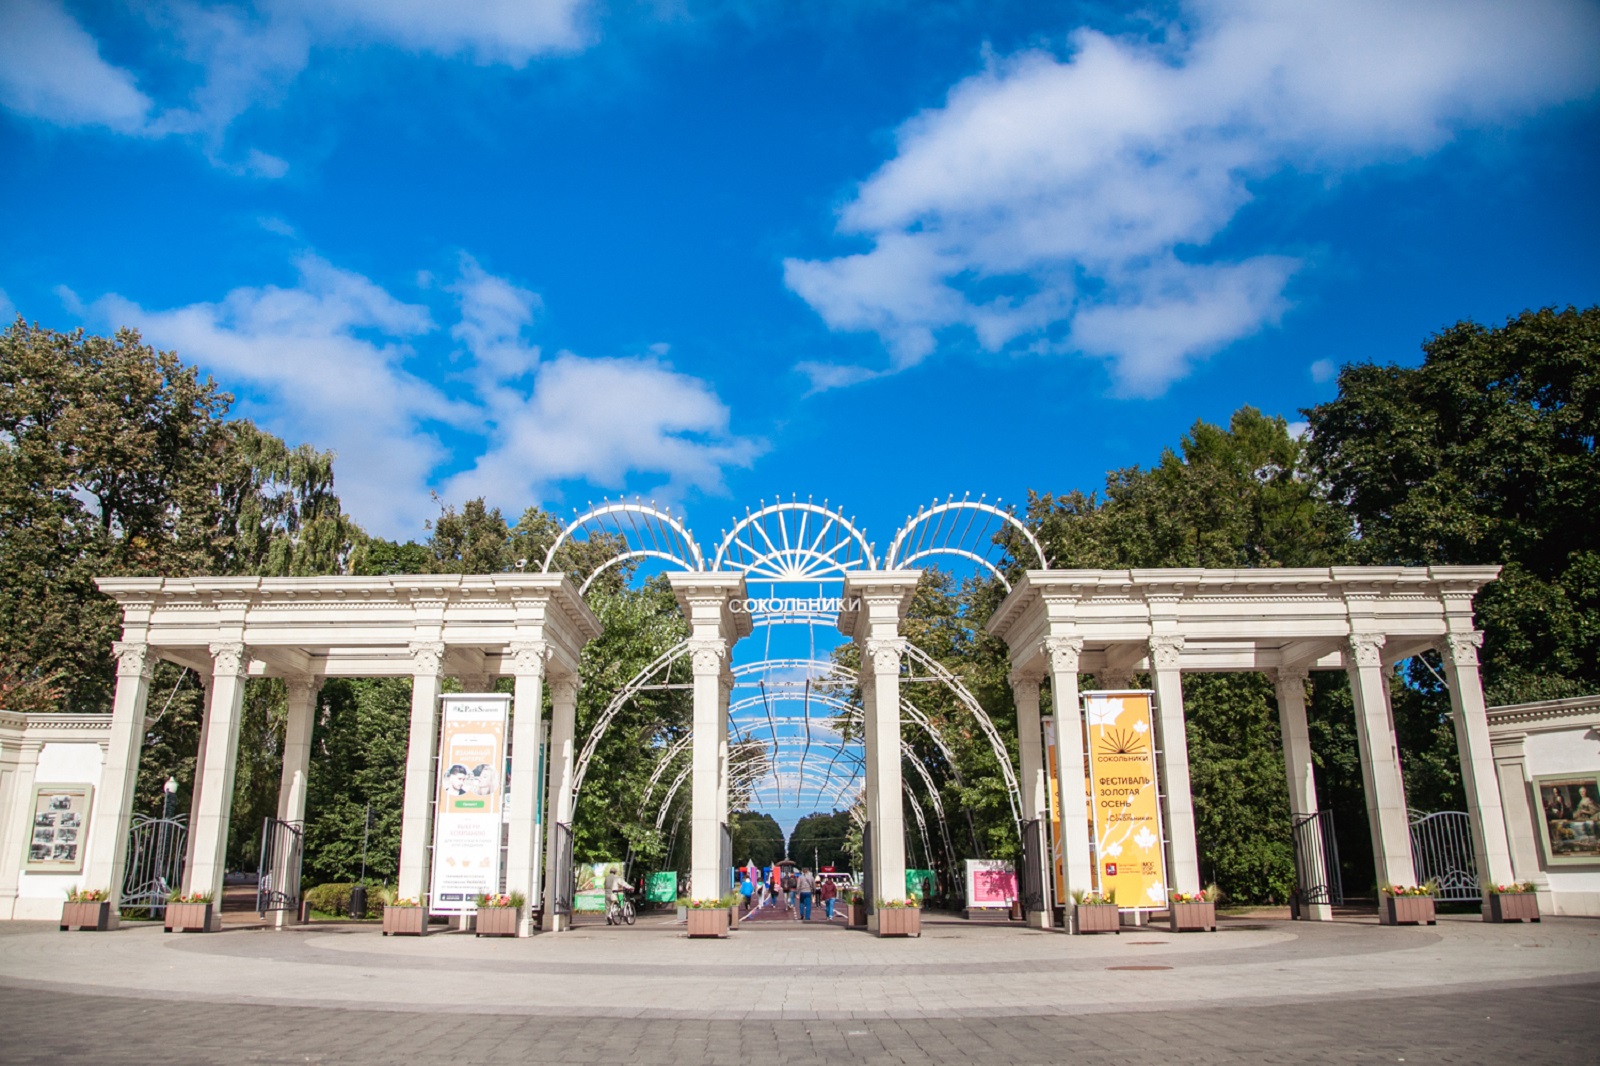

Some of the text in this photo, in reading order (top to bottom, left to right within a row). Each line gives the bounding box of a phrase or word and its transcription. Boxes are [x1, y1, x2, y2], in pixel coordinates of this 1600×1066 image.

[729, 597, 861, 613] СОКОЛЬНИКИ
[1097, 755, 1149, 763] СОКОЛЬНИКИ
[1099, 777, 1150, 786] ФЕСТИВАЛЬ
[1100, 788, 1140, 797] ЗОЛОТАЯ
[1100, 800, 1132, 808] ОСЕНЬ
